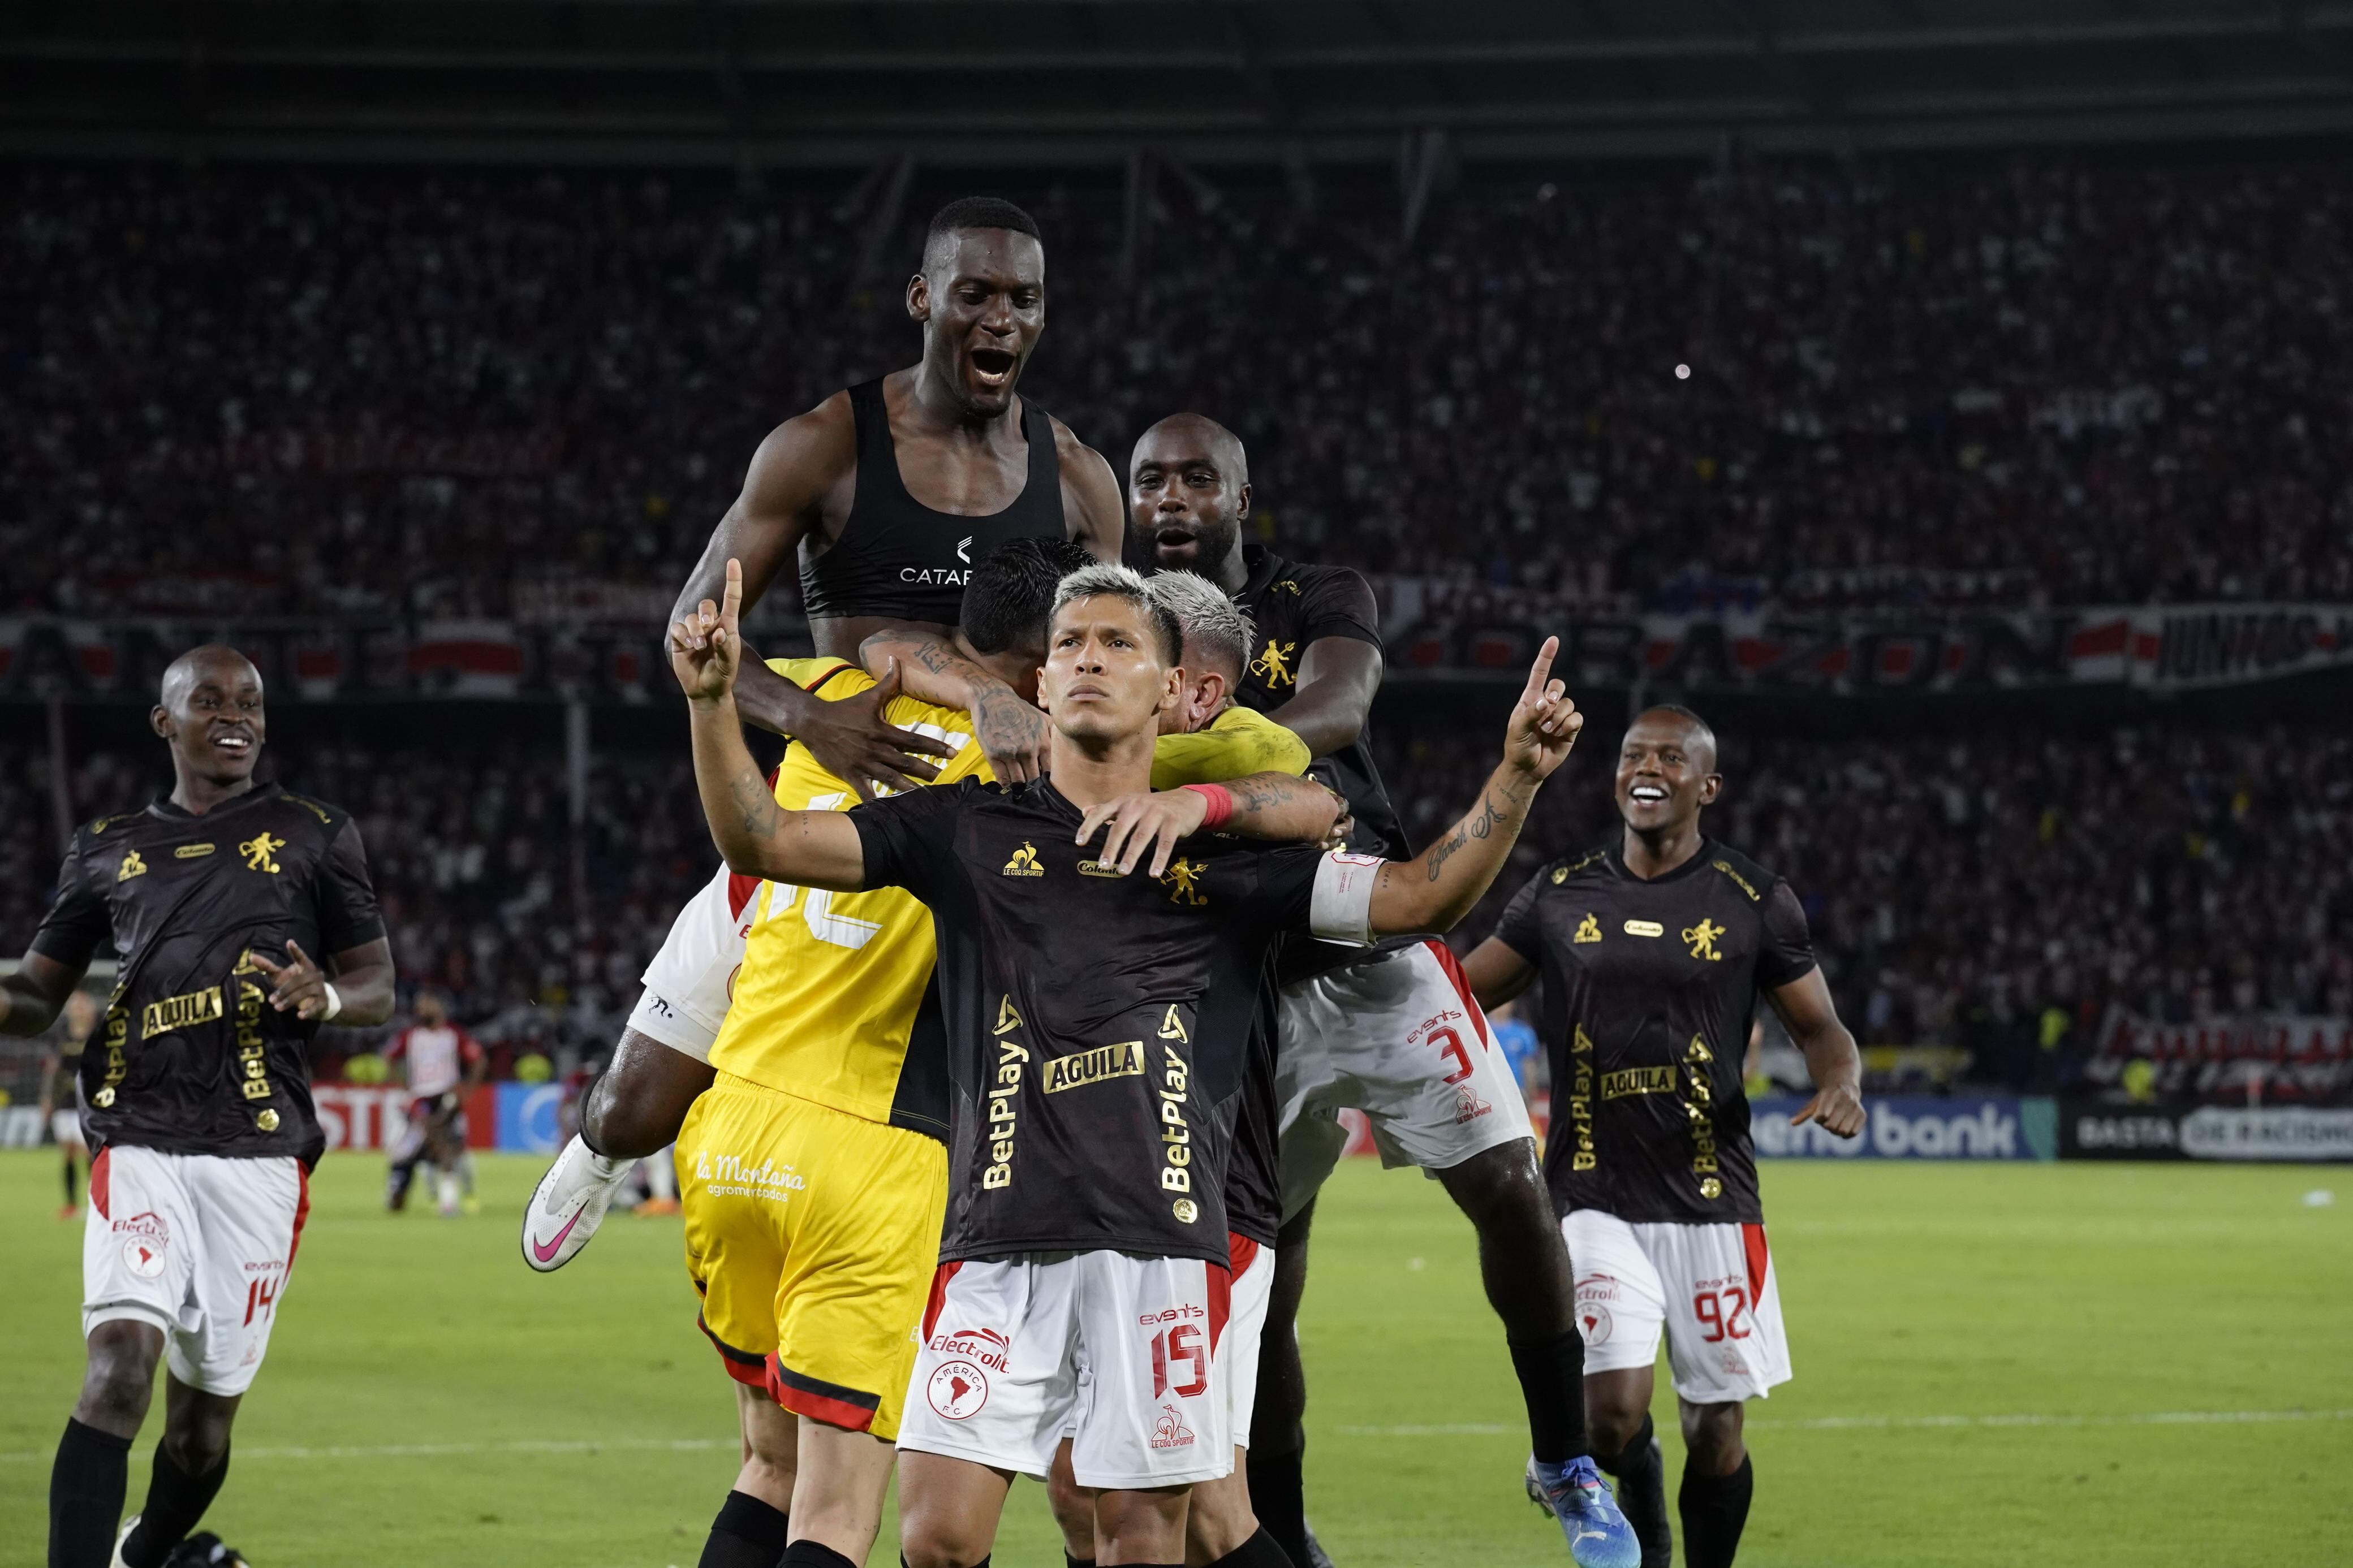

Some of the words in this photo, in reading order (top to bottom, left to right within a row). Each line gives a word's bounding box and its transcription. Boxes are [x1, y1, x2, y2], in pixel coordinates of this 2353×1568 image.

[146, 997, 216, 1032] AGUILA
[235, 980, 271, 1099] BetPlay
[1049, 1045, 1139, 1090] AGUILA
[1427, 1026, 1473, 1085] 3
[1606, 1069, 1669, 1096] AGUILA
[983, 1040, 1029, 1190] BetPlay
[1159, 1046, 1190, 1193] BetPlay
[1570, 1058, 1596, 1170] BetPlay
[1873, 1102, 2016, 1156] bank
[2077, 1116, 2174, 1148] BASTA
[697, 1151, 711, 1180] la
[715, 1155, 805, 1190] Montaña
[708, 1184, 788, 1202] agromercados
[243, 1276, 278, 1329] 14
[1693, 1286, 1751, 1342] 92
[936, 1364, 982, 1392] AMÉRICA
[1150, 1324, 1207, 1400] 15
[1172, 1437, 1194, 1446] SPORTIF
